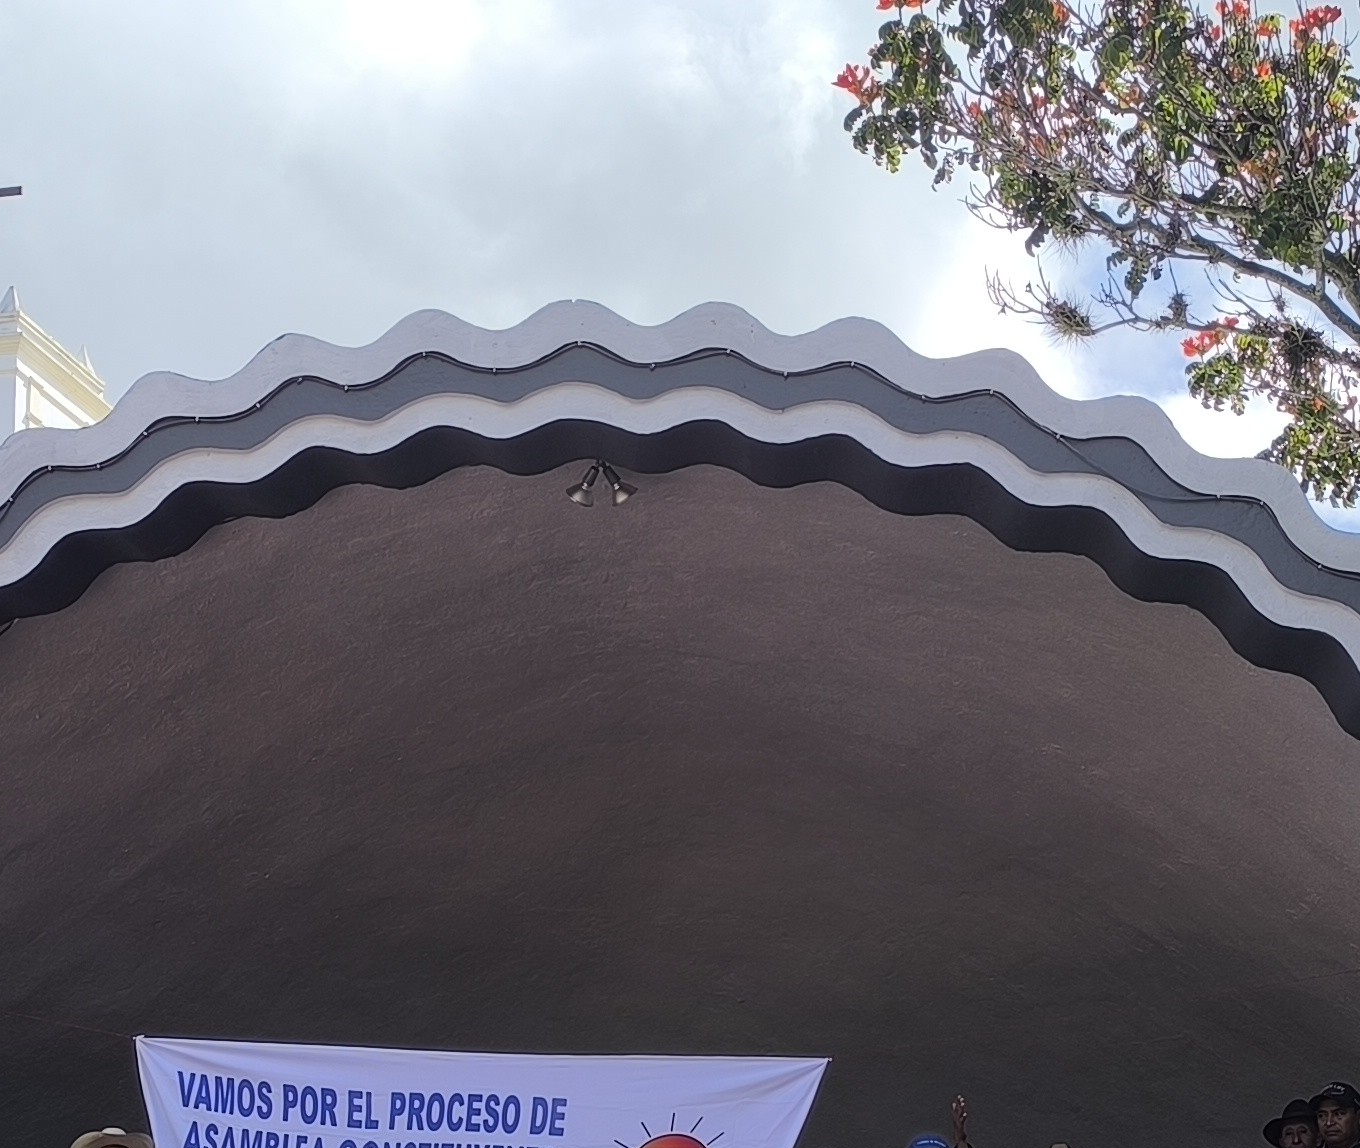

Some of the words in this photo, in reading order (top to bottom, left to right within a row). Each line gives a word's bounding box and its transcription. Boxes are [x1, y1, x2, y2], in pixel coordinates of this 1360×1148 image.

[176, 1070, 273, 1120] VAMOS
[282, 1085, 337, 1127] POR
[347, 1089, 380, 1130] EL
[389, 1091, 521, 1136] PROCESO
[530, 1096, 567, 1137] DE
